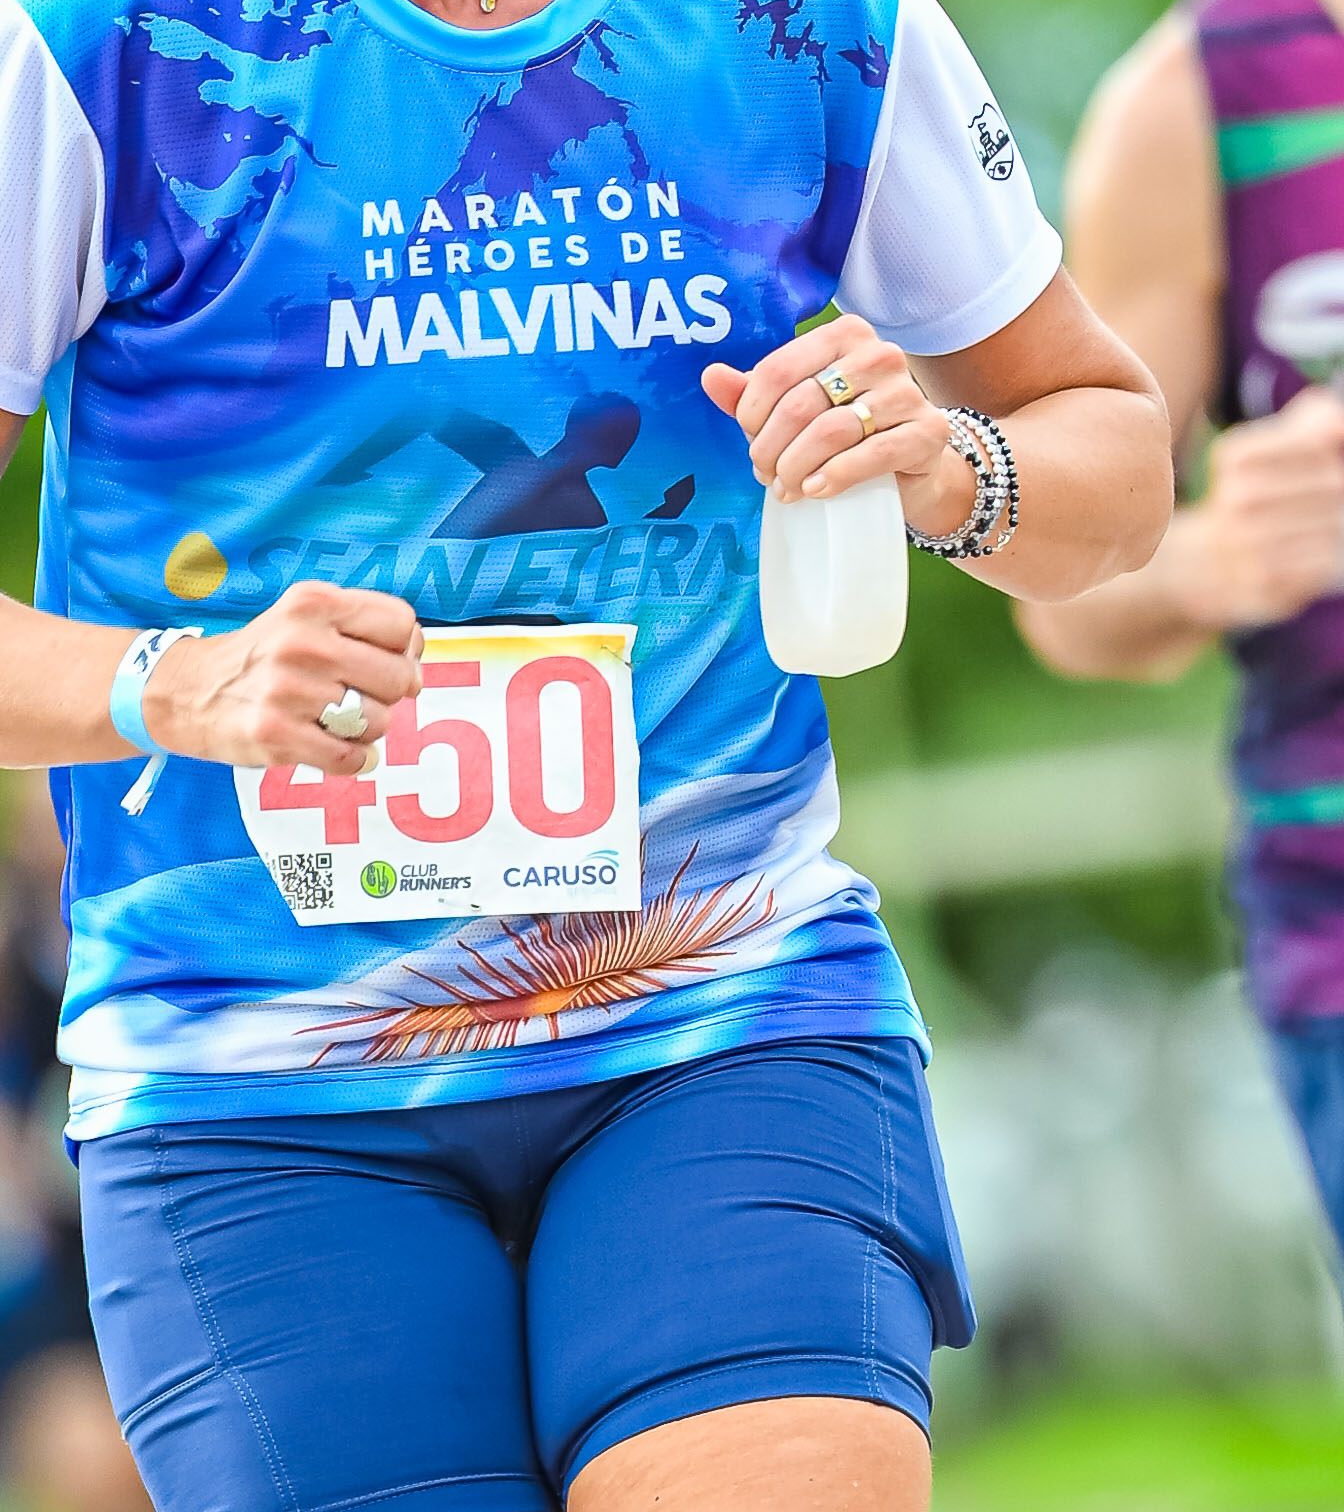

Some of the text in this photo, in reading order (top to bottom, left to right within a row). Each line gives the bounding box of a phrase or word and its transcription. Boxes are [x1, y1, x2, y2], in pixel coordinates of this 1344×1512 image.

[361, 178, 681, 237] MARATÓN
[365, 229, 685, 281] HÉROES DE
[325, 274, 732, 368] MALVINAS
[259, 655, 616, 846] 450
[399, 876, 472, 892] RUNNER'S
[400, 864, 438, 878] CLUB
[503, 864, 618, 888] CARUSO
